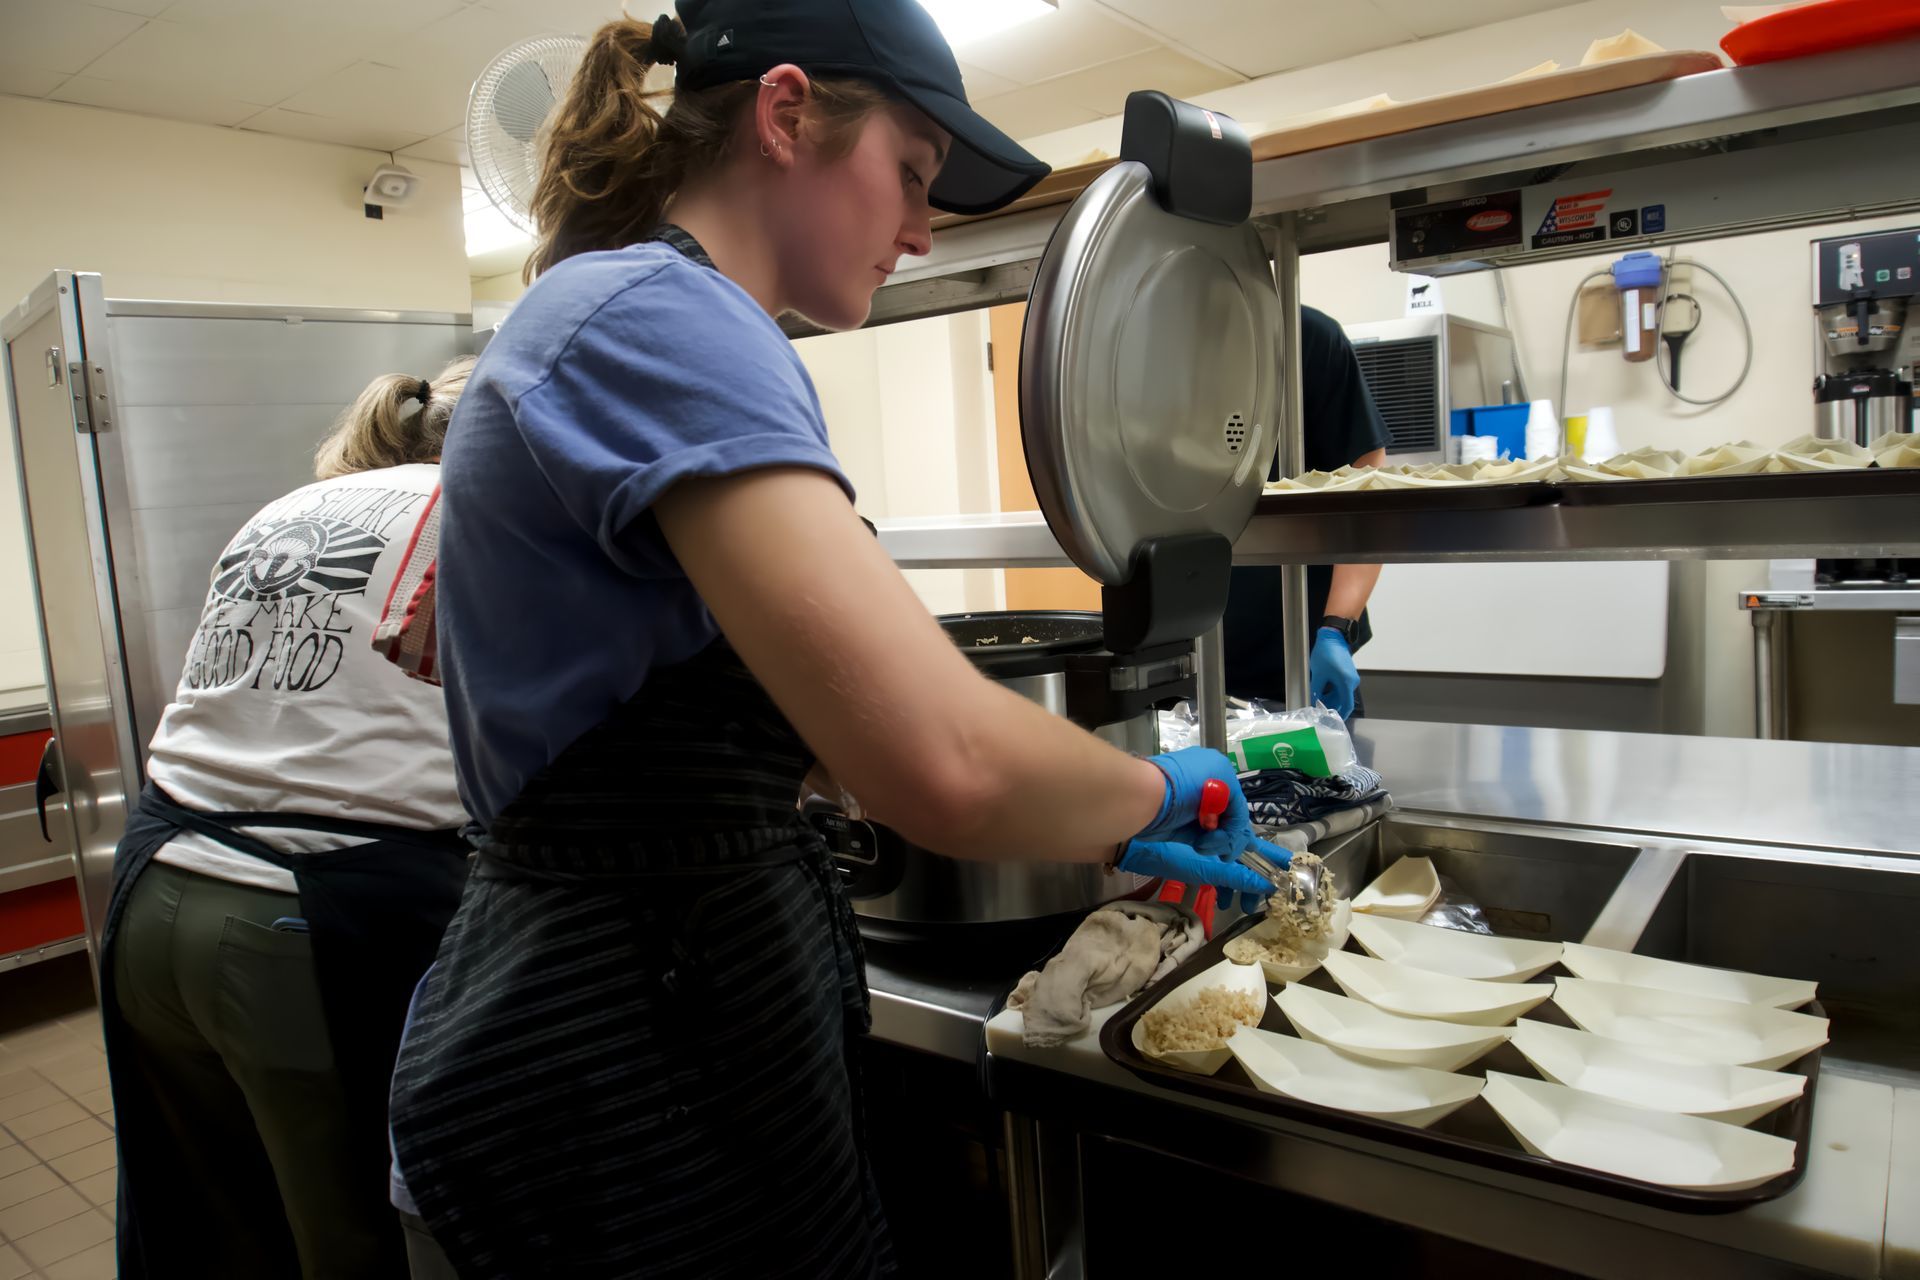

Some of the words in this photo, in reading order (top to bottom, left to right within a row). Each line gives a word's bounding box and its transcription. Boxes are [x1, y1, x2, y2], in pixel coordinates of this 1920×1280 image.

[245, 590, 366, 633] MAKE
[189, 628, 254, 690] GOOD
[251, 630, 344, 692] FOOD
